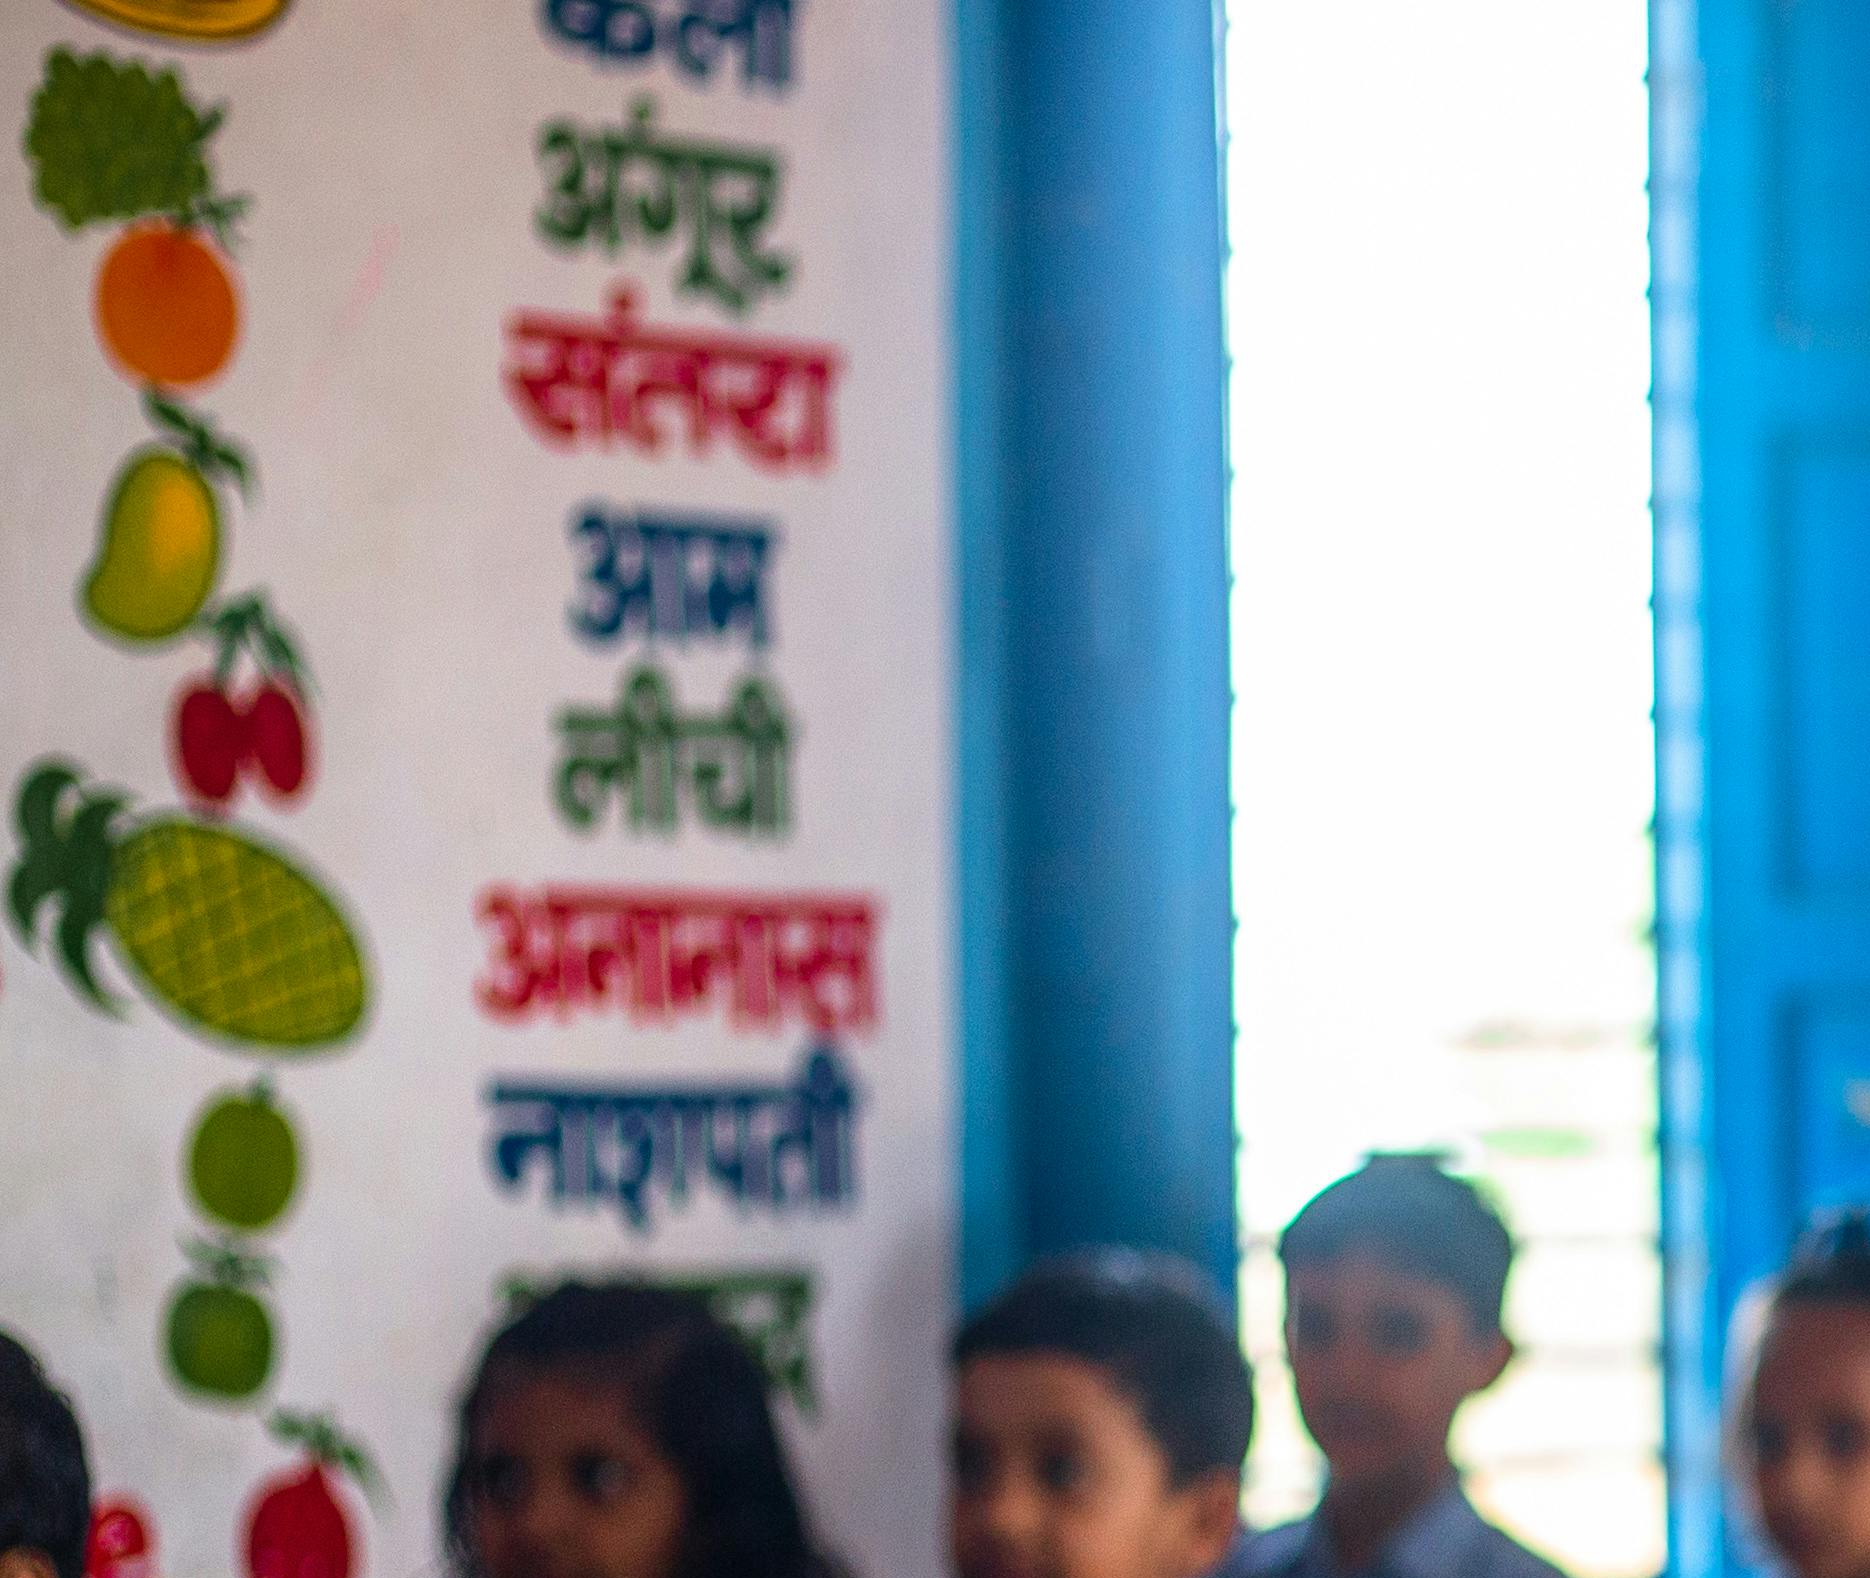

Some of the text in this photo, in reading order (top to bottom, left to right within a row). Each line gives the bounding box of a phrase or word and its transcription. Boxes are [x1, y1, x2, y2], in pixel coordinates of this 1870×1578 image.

[537, 0, 802, 93] कला
[536, 97, 793, 317] अंगूर
[504, 285, 841, 471] संतरा
[570, 503, 781, 657] आम
[553, 662, 796, 837] लीची
[479, 887, 880, 1035] अनानास
[485, 1040, 867, 1230] नाशपती
